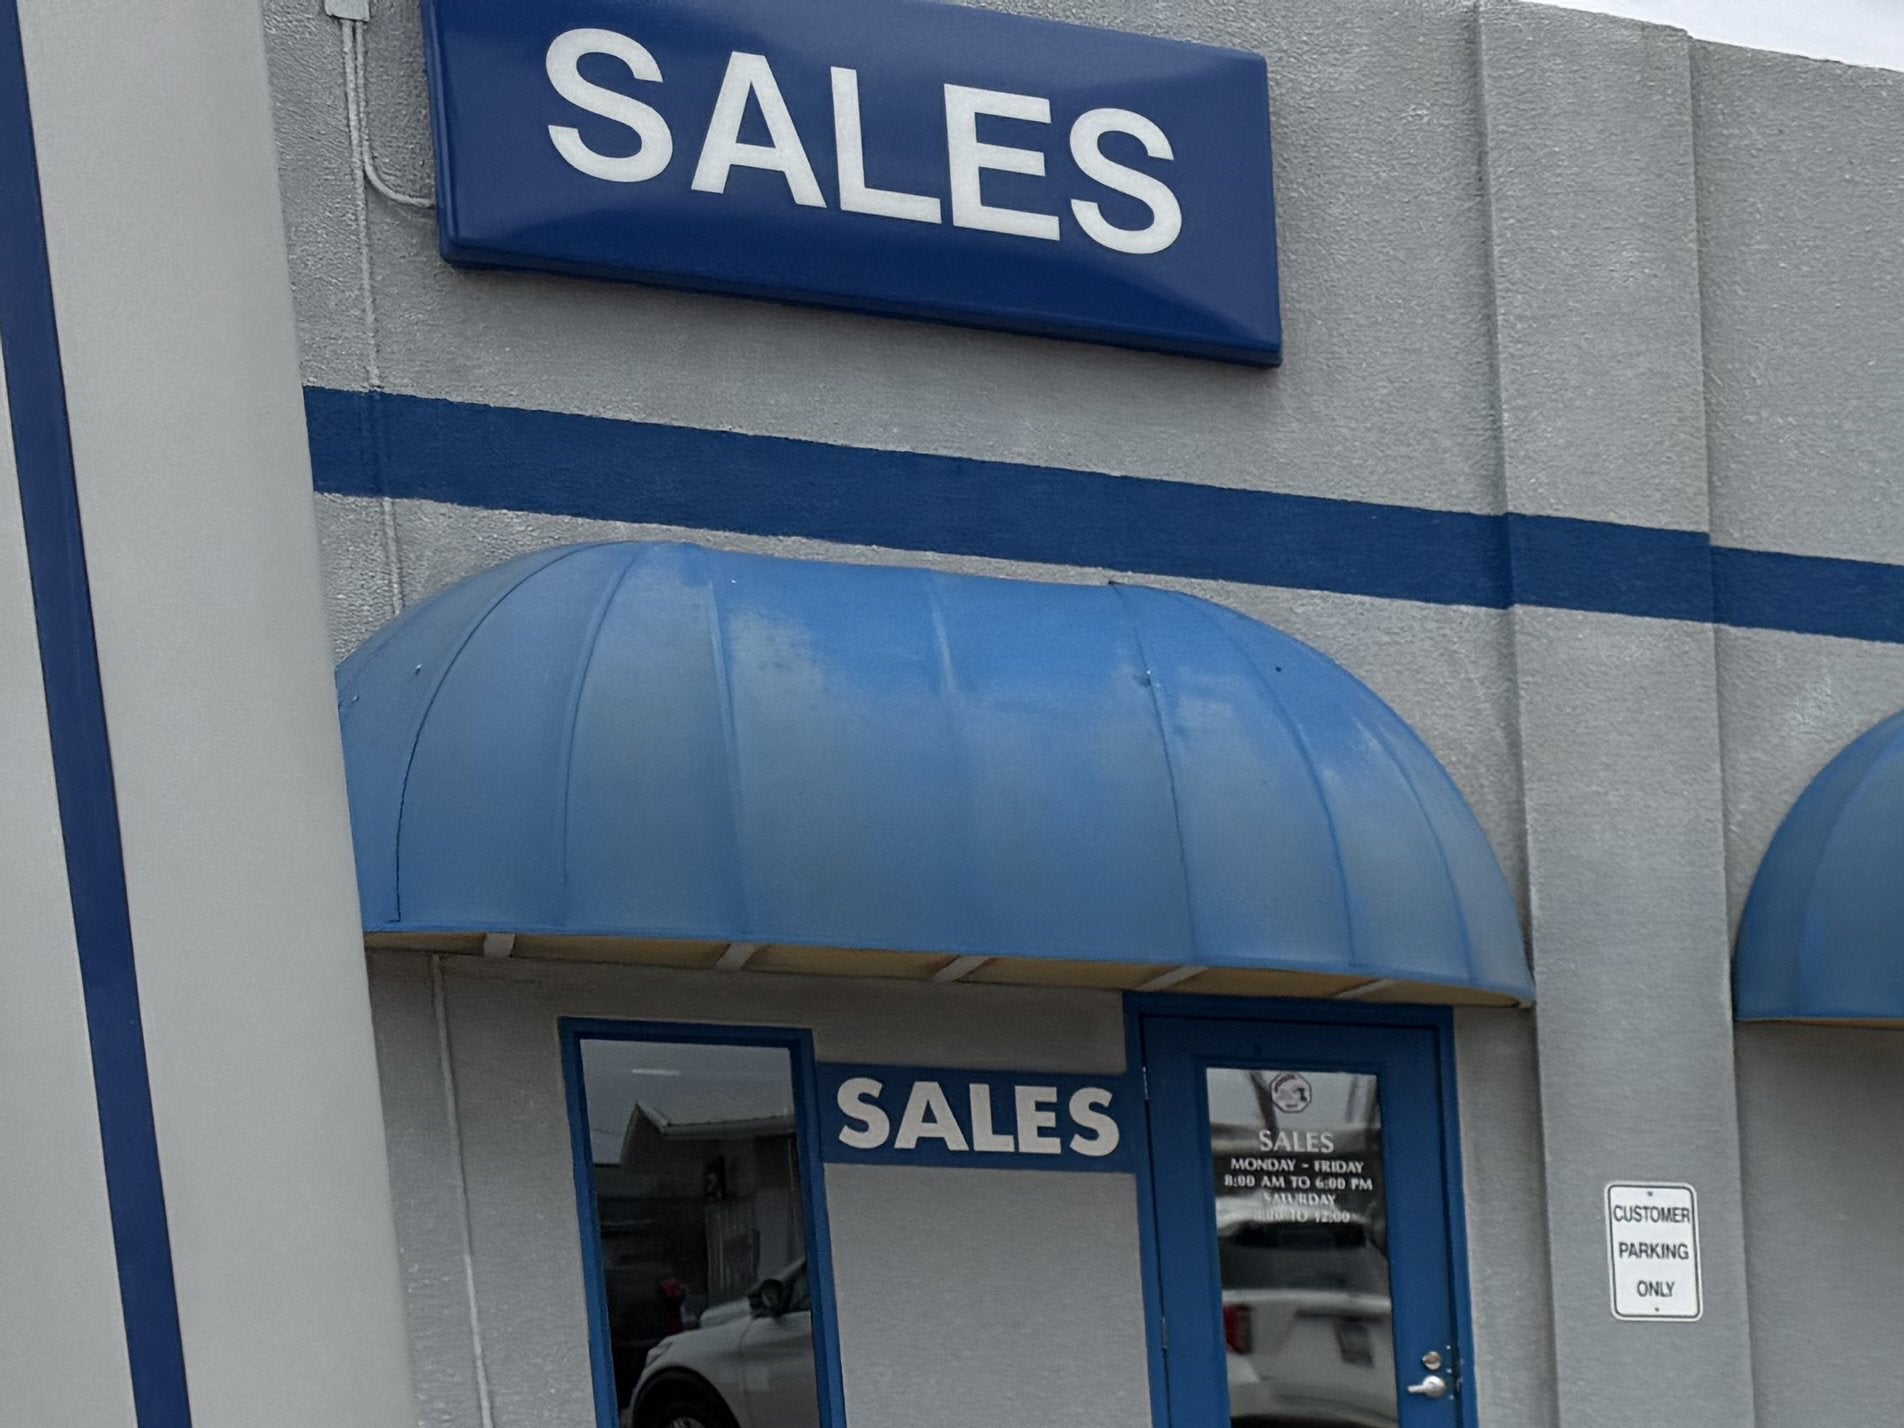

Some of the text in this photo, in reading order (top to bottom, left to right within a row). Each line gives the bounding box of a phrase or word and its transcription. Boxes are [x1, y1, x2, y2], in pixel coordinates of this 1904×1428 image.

[545, 27, 1183, 256] SALES
[836, 1076, 1121, 1157] SALES
[1258, 1129, 1335, 1154] SALES
[1230, 1157, 1297, 1172] MONDAY
[1313, 1159, 1365, 1174] FRIDAY
[1224, 1174, 1374, 1191] 8:00 AM TO 6:00 PM
[1263, 1191, 1337, 1206] SATURDAY
[1613, 1204, 1691, 1223] CUSTOMER
[1618, 1241, 1689, 1260] PARKING
[1636, 1279, 1675, 1298] ONLY
